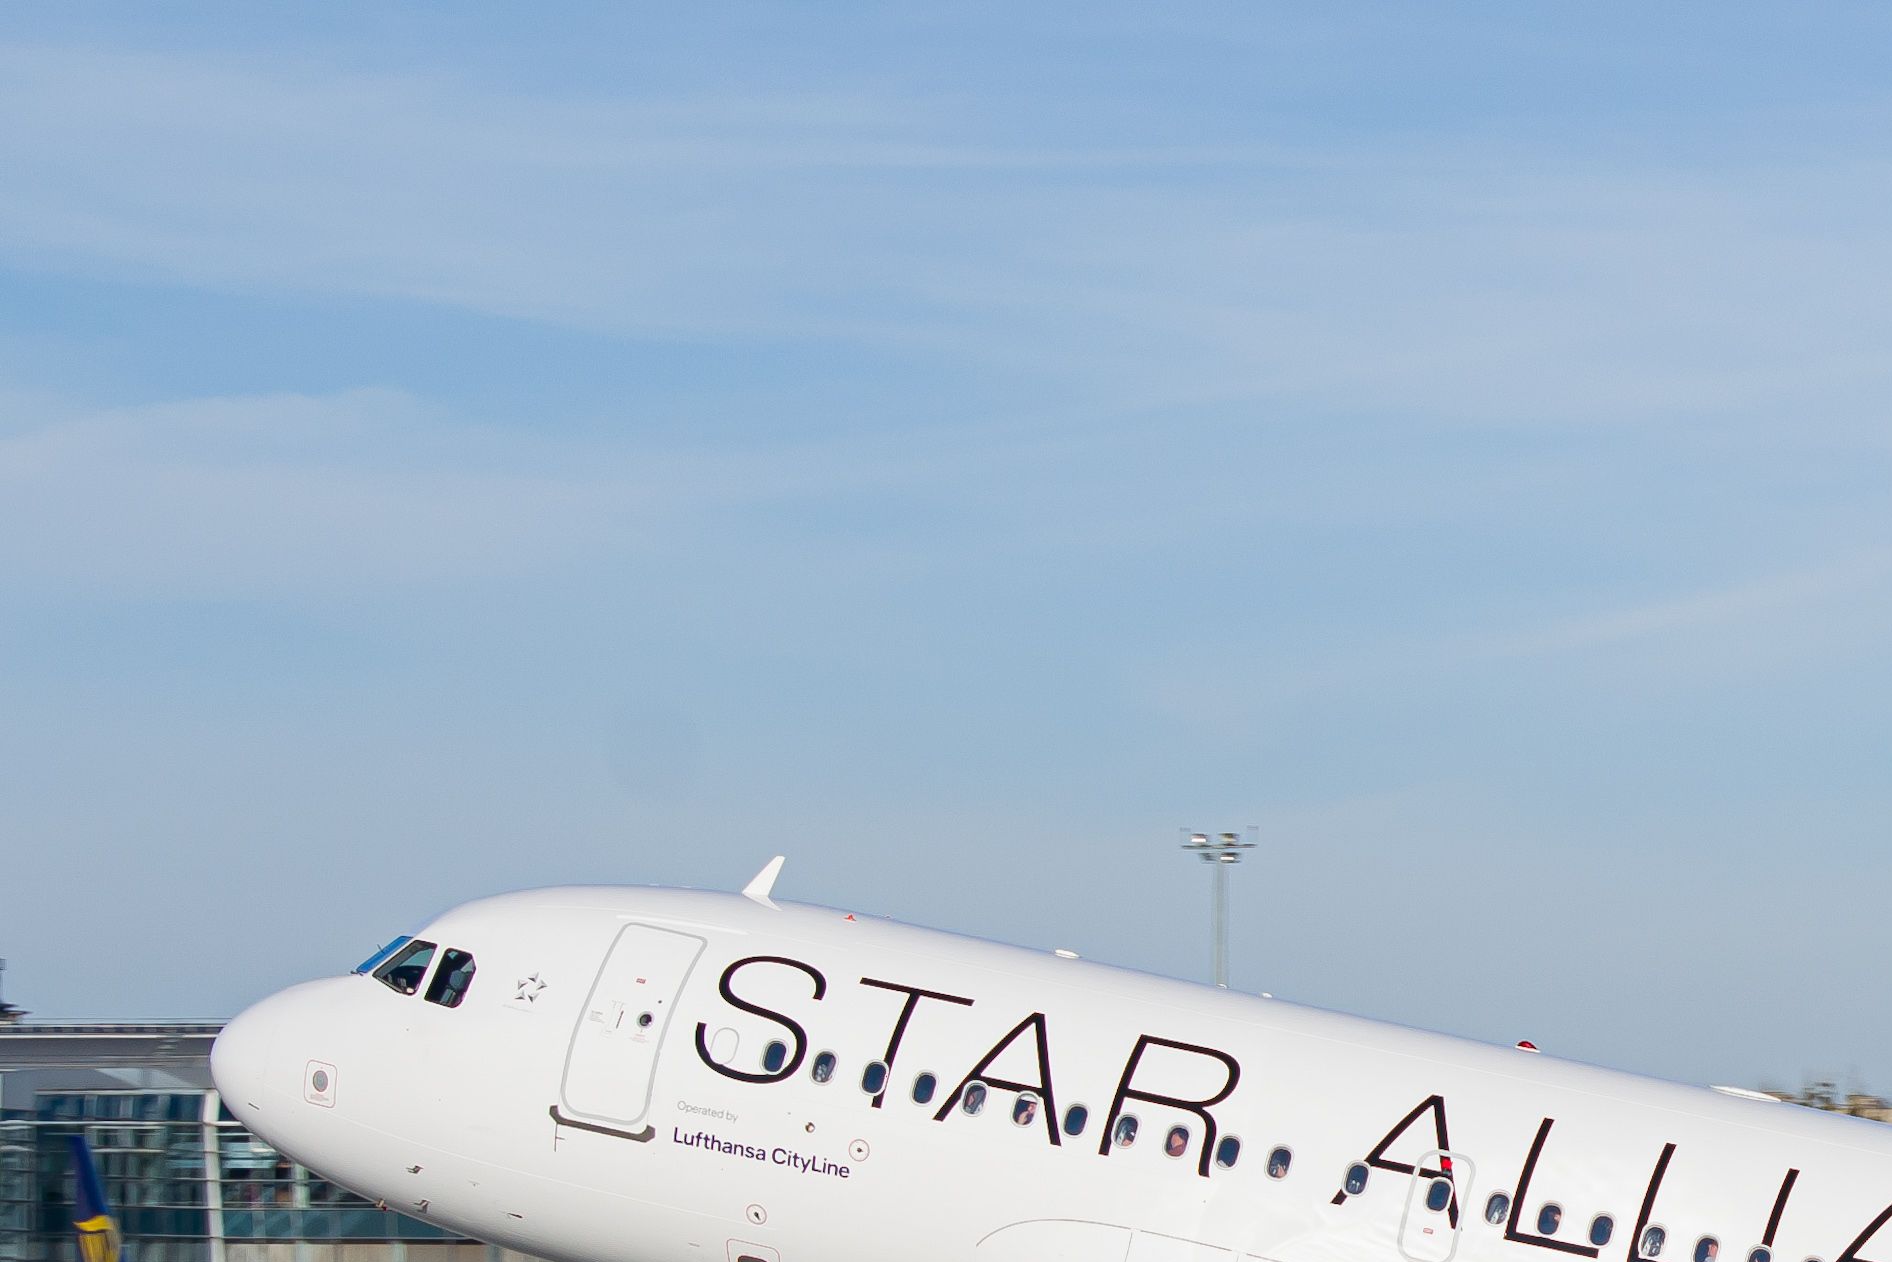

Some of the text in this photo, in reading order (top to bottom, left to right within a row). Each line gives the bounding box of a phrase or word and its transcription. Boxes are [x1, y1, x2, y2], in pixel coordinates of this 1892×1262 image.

[695, 956, 1241, 1178] STAR
[676, 1100, 739, 1124] Operated by
[673, 1126, 850, 1179] Lufthansa CityLine
